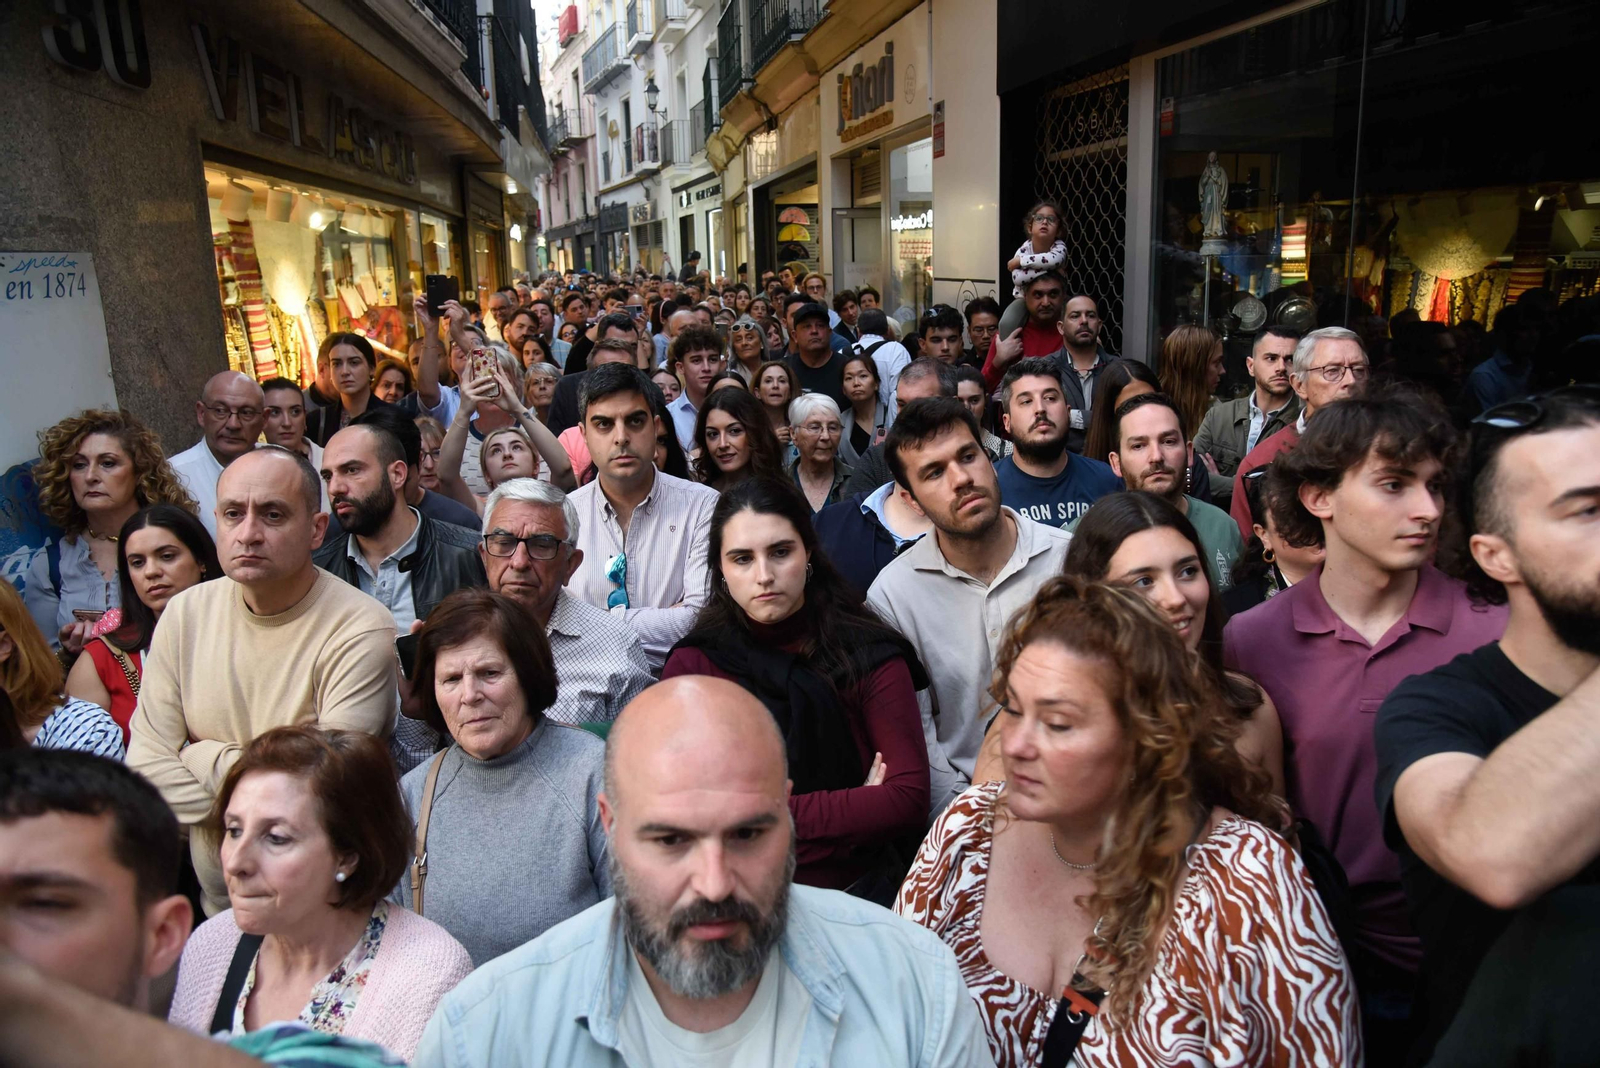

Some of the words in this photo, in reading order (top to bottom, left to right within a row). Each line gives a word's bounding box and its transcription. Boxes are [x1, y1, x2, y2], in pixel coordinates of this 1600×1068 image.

[6, 280, 34, 300] en
[43, 272, 86, 299] 1874
[1057, 502, 1094, 520] SPIR
